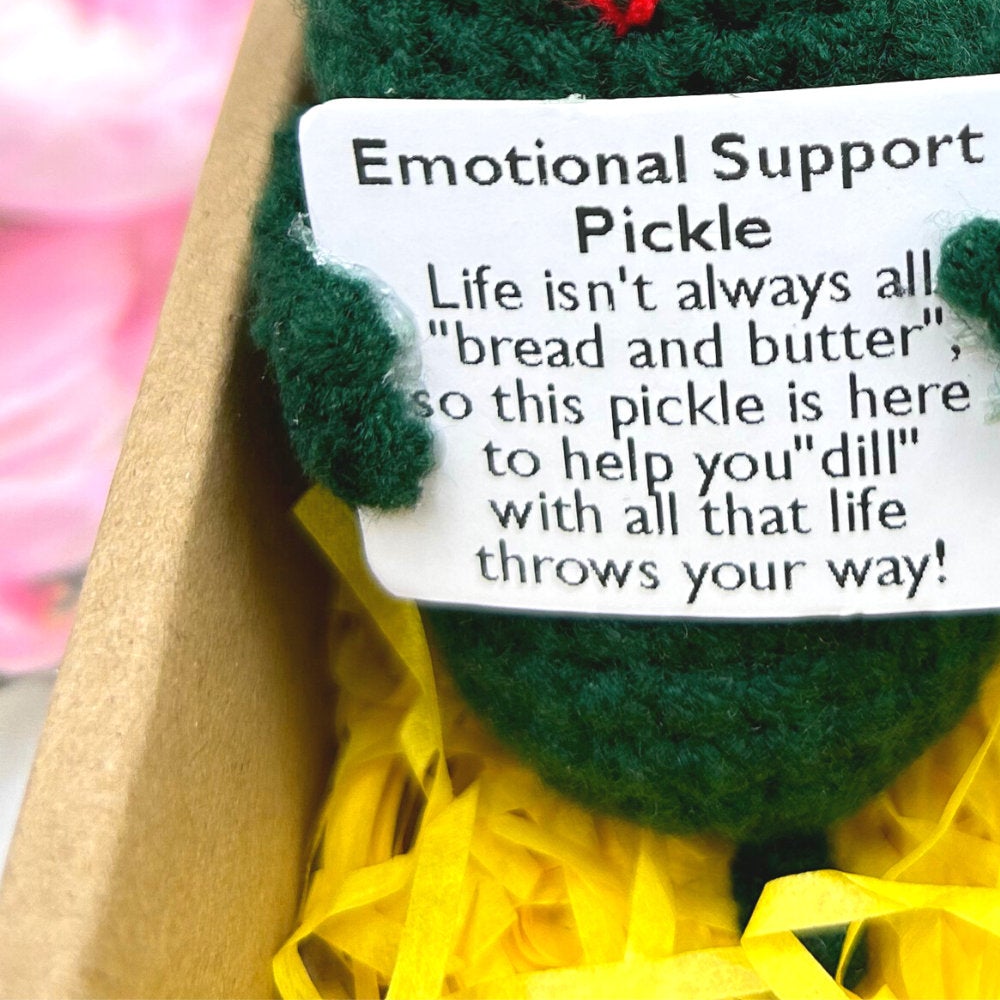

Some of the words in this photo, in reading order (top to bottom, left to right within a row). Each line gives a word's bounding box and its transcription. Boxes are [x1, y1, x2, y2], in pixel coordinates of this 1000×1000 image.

[352, 134, 686, 185] Emotional
[711, 123, 986, 192] Support
[575, 203, 774, 254] Pickle
[427, 262, 523, 310] Life
[544, 265, 657, 312] isn't
[677, 263, 852, 319] always
[876, 249, 932, 298] all
[428, 319, 604, 367] "bread
[629, 321, 723, 367] and
[749, 306, 962, 365] butter",
[411, 388, 473, 420] so
[491, 377, 584, 423] this
[610, 379, 765, 439] pickle
[788, 380, 823, 422] is
[849, 371, 970, 418] here
[483, 440, 541, 477] to
[563, 434, 673, 495] help
[489, 489, 602, 535] with
[625, 489, 679, 535] all
[700, 491, 811, 535] that
[831, 486, 907, 532] life
[475, 539, 660, 590] throws
[682, 560, 807, 604] your
[827, 538, 947, 598] way!
